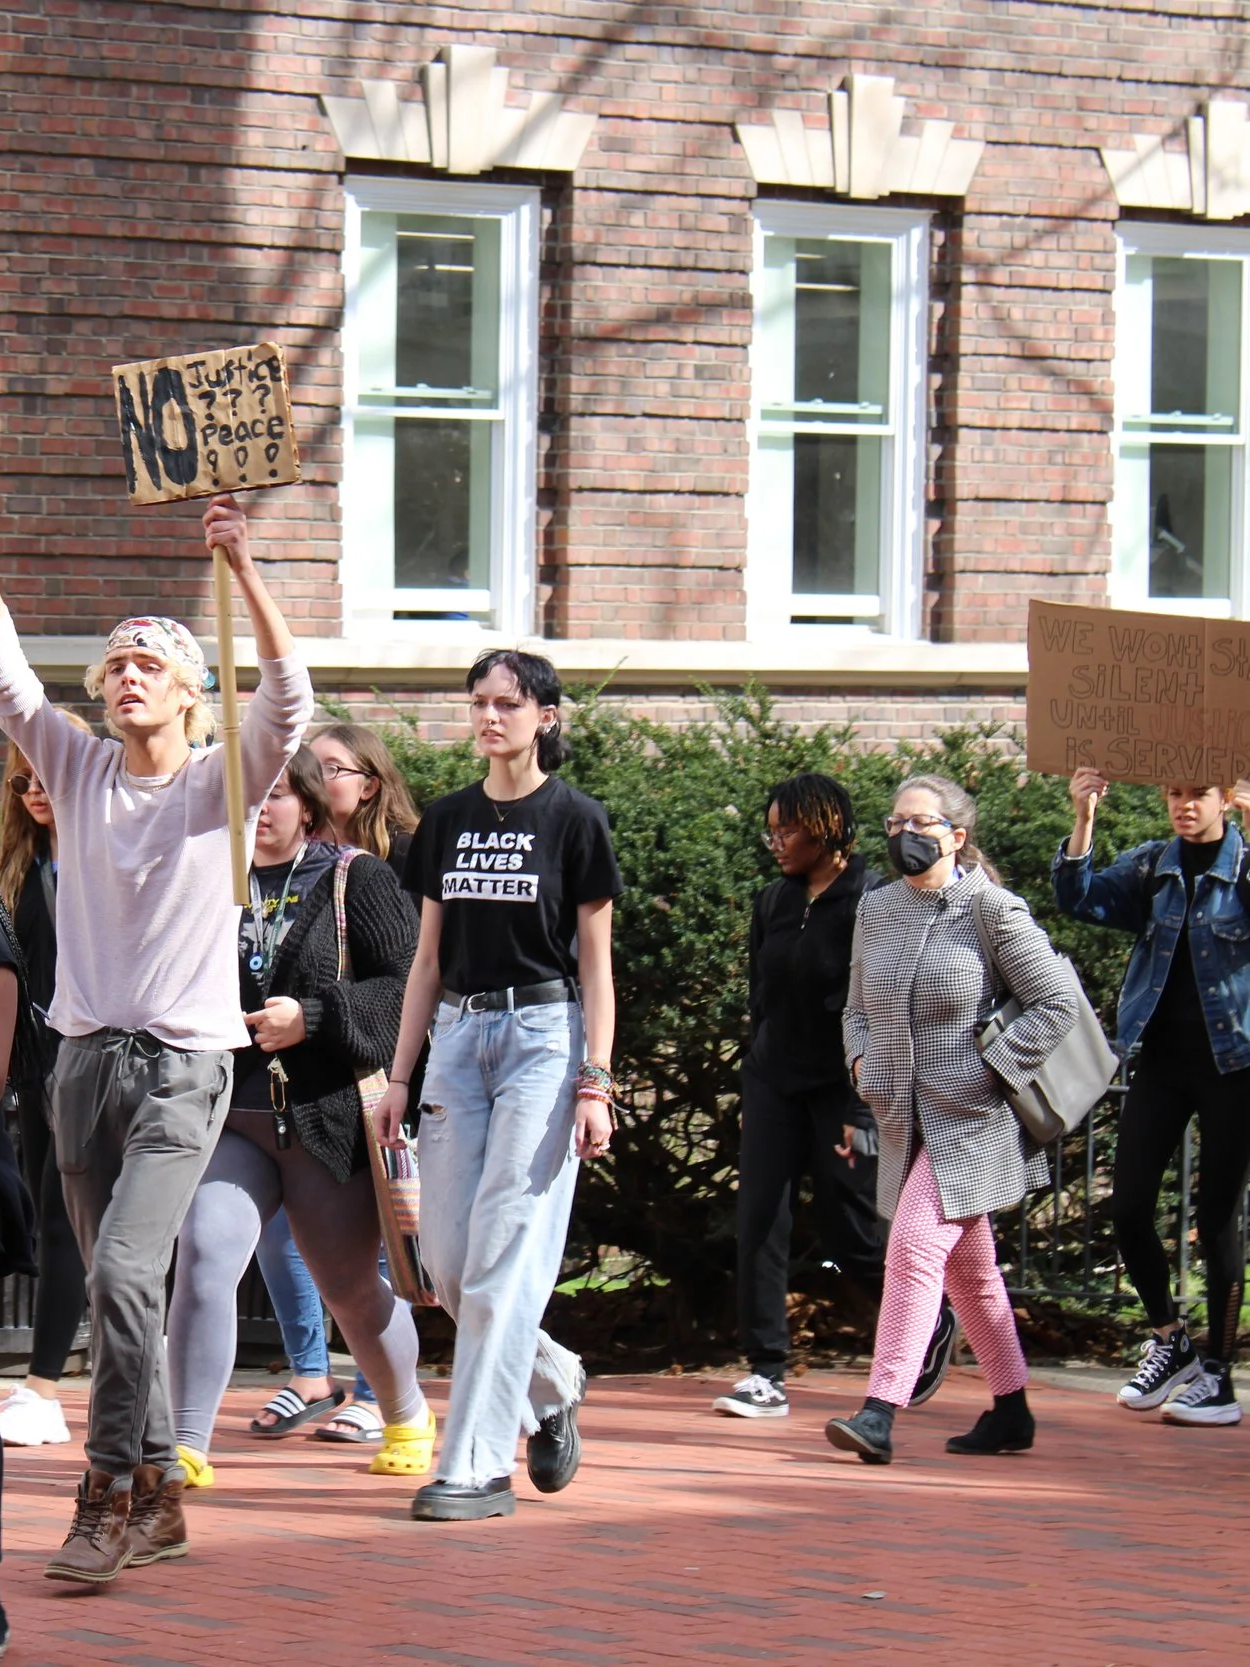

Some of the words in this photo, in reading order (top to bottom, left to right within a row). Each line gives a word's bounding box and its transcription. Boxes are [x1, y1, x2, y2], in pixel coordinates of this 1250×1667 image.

[186, 349, 284, 388] Justice
[118, 366, 199, 495] NO
[1038, 615, 1094, 656] WE
[456, 831, 536, 852] BLACK
[455, 852, 524, 871] LIVES
[443, 877, 533, 897] MATTER
